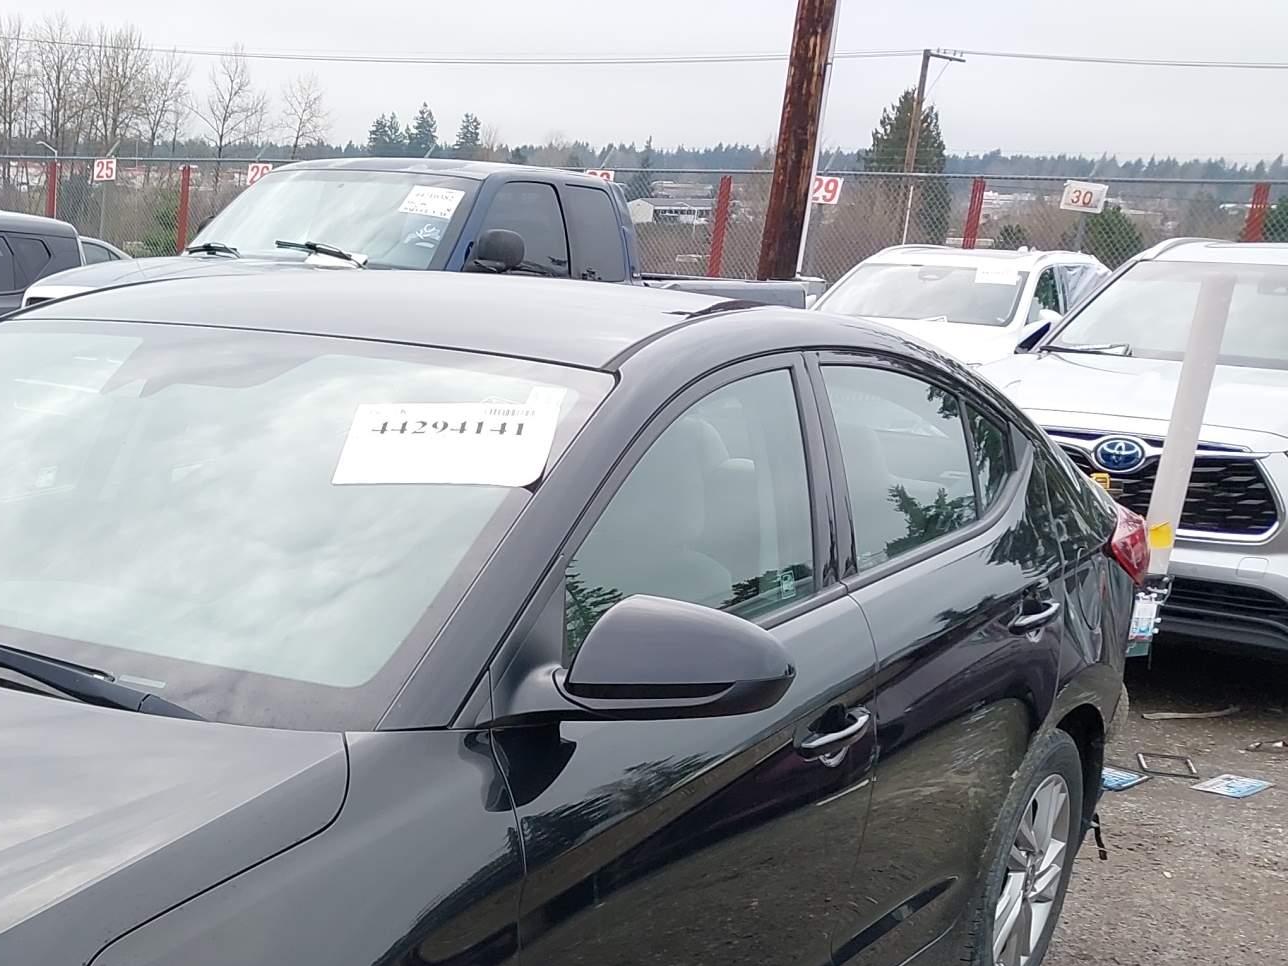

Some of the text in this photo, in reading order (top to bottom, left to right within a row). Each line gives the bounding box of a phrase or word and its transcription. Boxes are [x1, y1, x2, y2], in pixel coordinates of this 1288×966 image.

[96, 160, 114, 178] 25
[812, 177, 839, 202] 29
[1070, 189, 1093, 205] 30
[370, 419, 526, 436] 44294141
